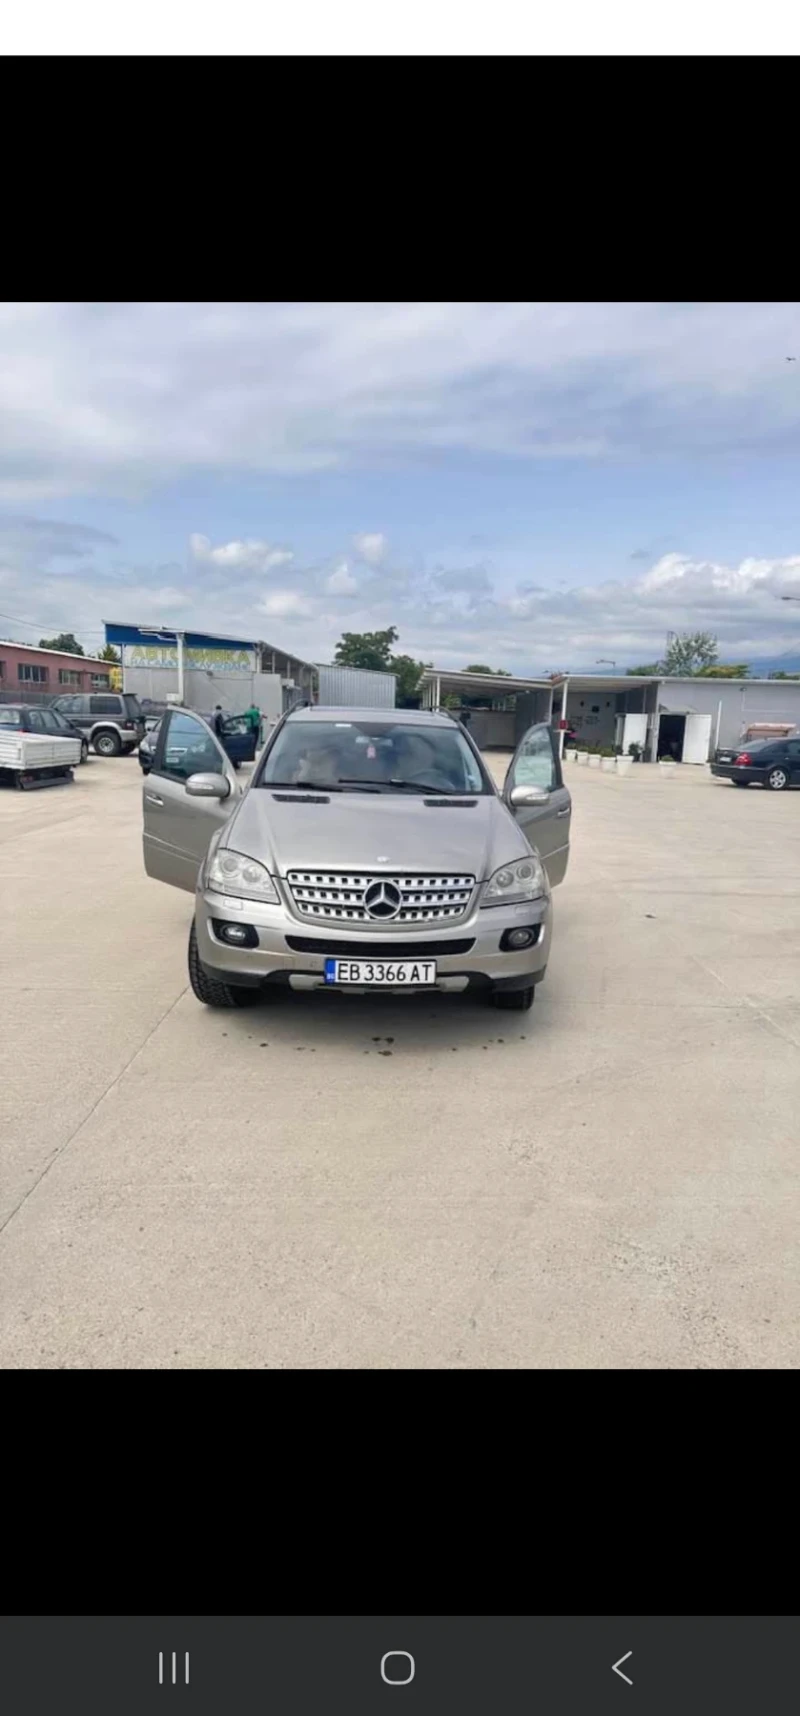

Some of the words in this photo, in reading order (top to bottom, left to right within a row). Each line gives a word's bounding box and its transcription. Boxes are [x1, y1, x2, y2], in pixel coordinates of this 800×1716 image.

[338, 963, 360, 981] EB
[364, 964, 406, 981] 3366
[410, 964, 432, 981] AT
